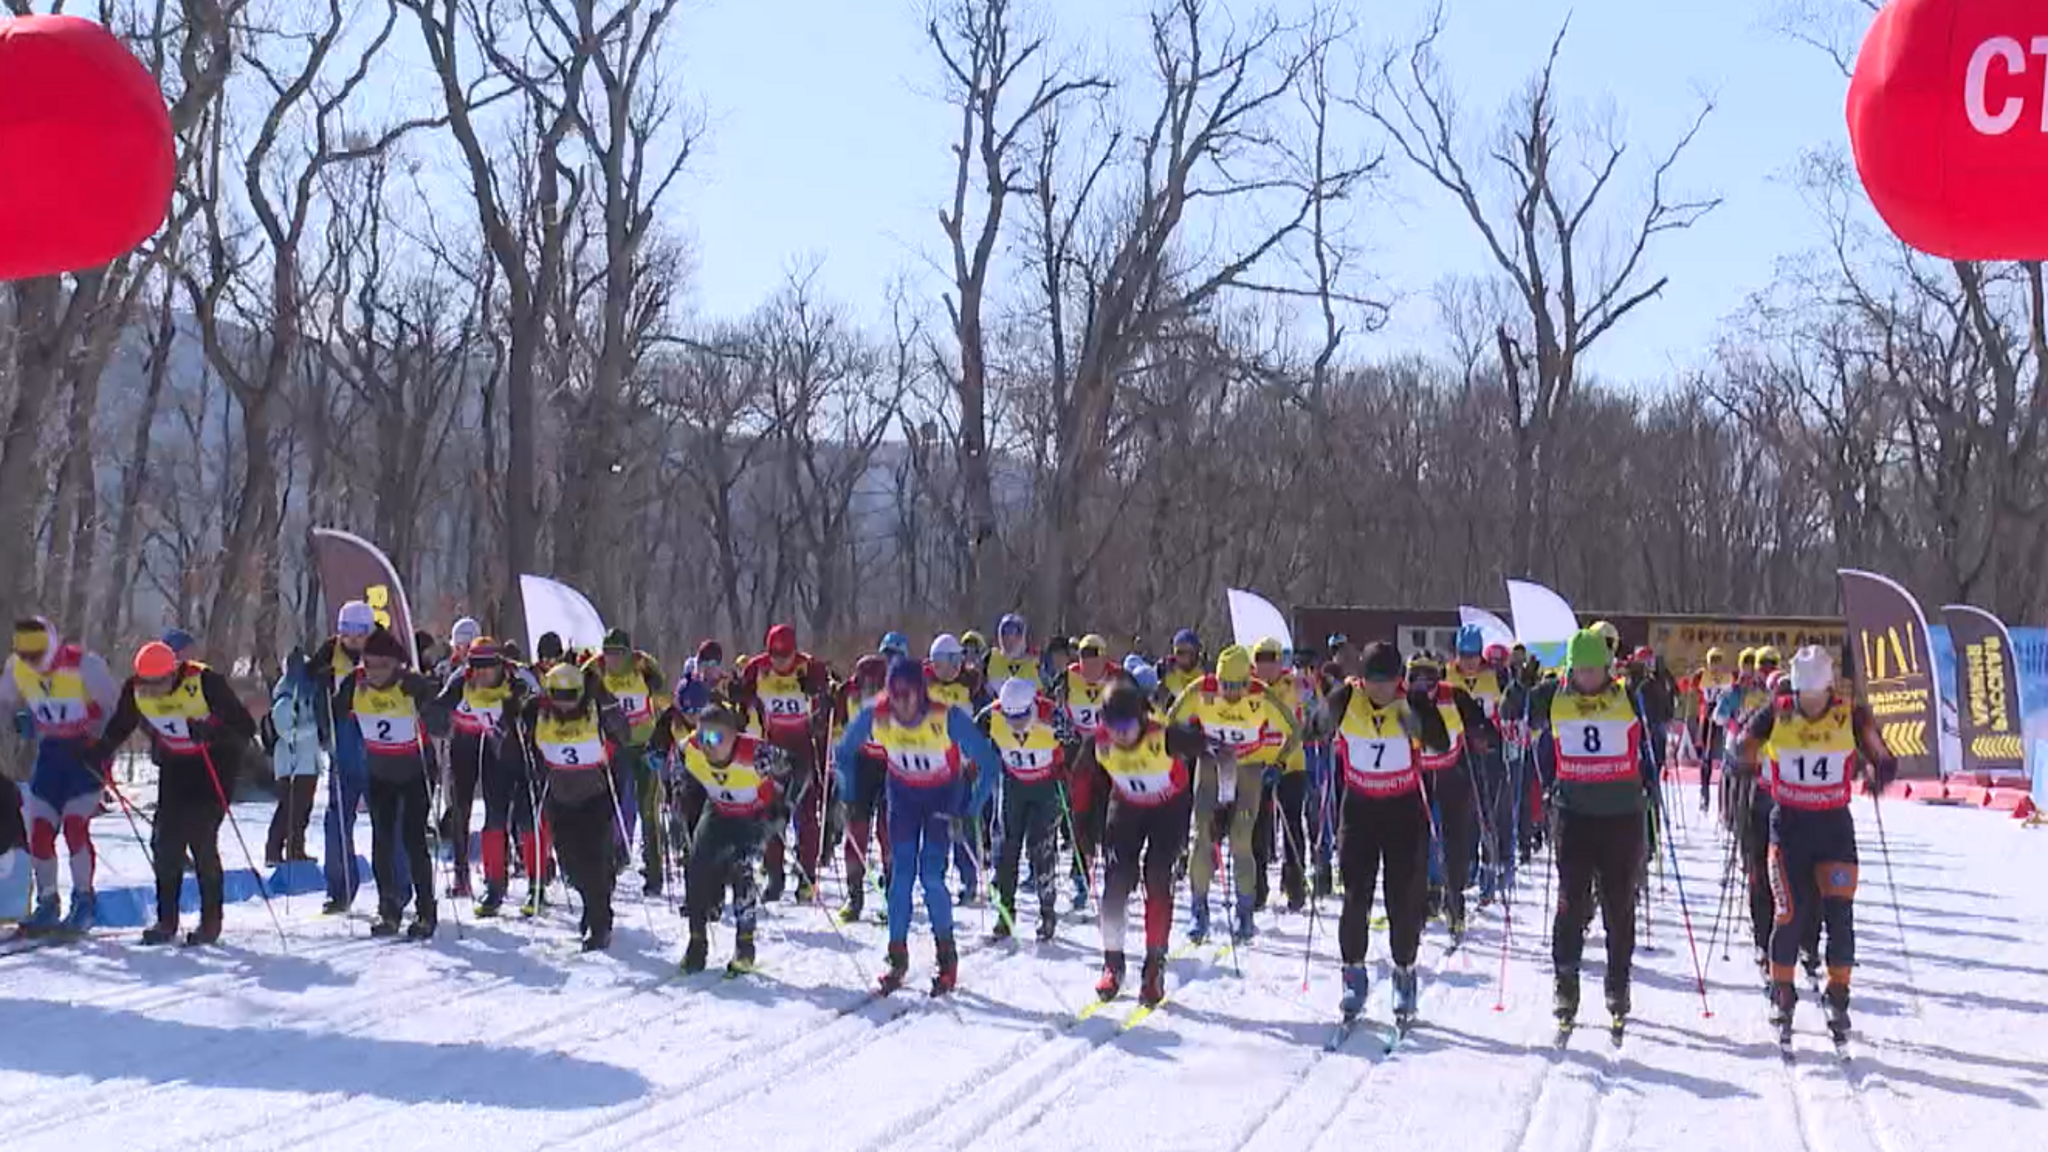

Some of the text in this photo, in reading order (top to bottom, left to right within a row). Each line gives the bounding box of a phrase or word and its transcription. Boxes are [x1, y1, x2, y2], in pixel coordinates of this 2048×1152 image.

[377, 720, 392, 740] 2
[1584, 725, 1601, 753] 8
[562, 747, 579, 765] 3
[1371, 743, 1386, 769] 7
[1793, 756, 1829, 781] 14
